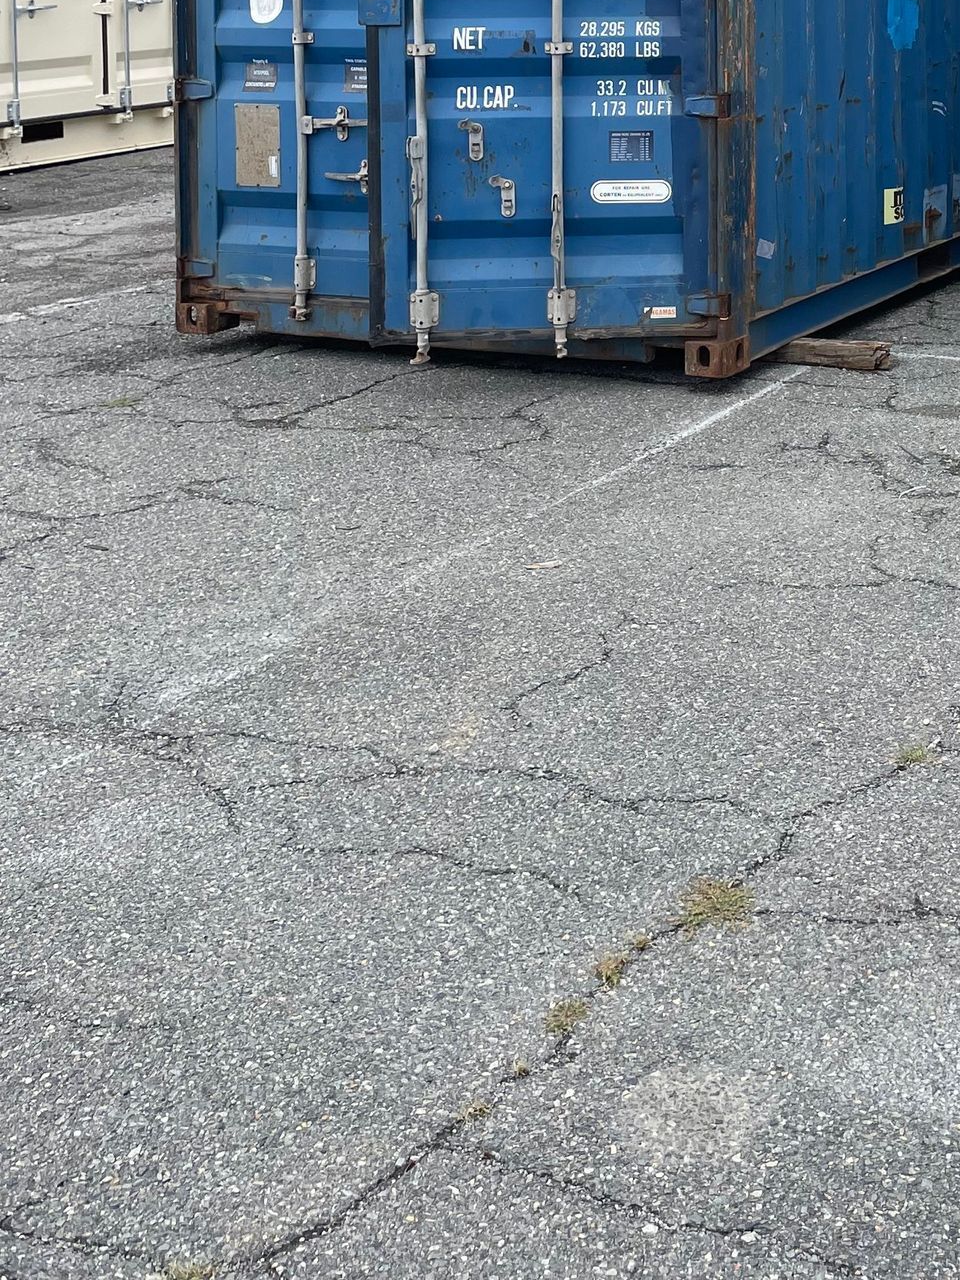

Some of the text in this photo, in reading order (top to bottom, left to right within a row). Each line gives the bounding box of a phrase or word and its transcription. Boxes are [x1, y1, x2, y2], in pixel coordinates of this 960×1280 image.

[453, 27, 486, 50] NET
[635, 21, 660, 37] KGS
[635, 41, 660, 58] LBS
[483, 85, 519, 109] CAP.
[596, 80, 627, 96] 33.2
